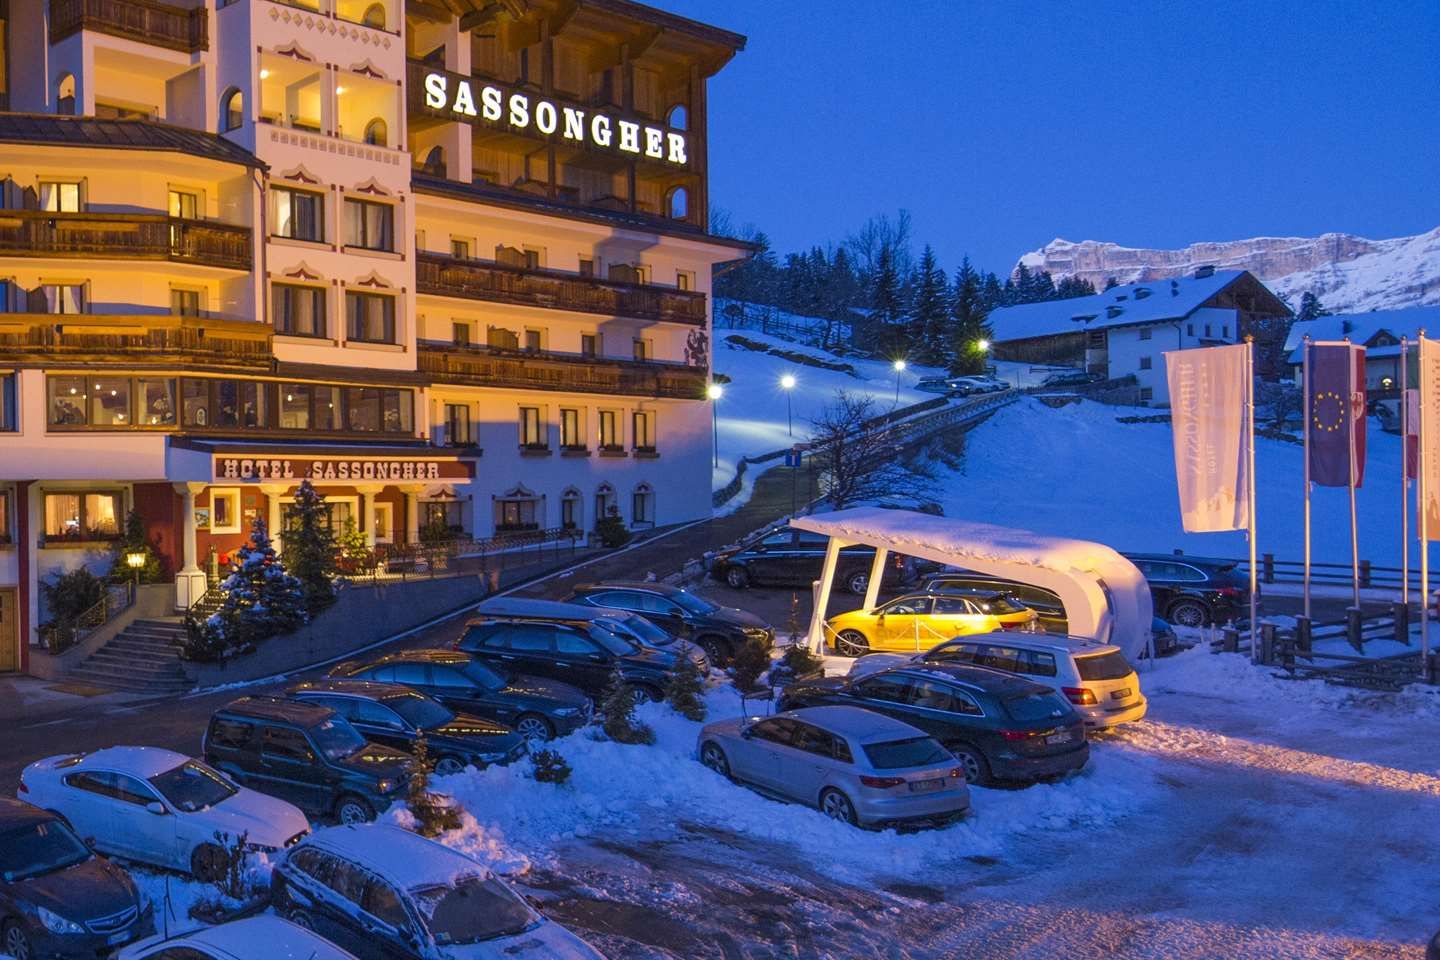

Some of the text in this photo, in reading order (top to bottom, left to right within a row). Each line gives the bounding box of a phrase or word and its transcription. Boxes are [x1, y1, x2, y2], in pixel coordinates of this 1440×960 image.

[424, 73, 687, 165] SASSONGHER
[224, 459, 440, 480] HOTEL SASSONGHER
